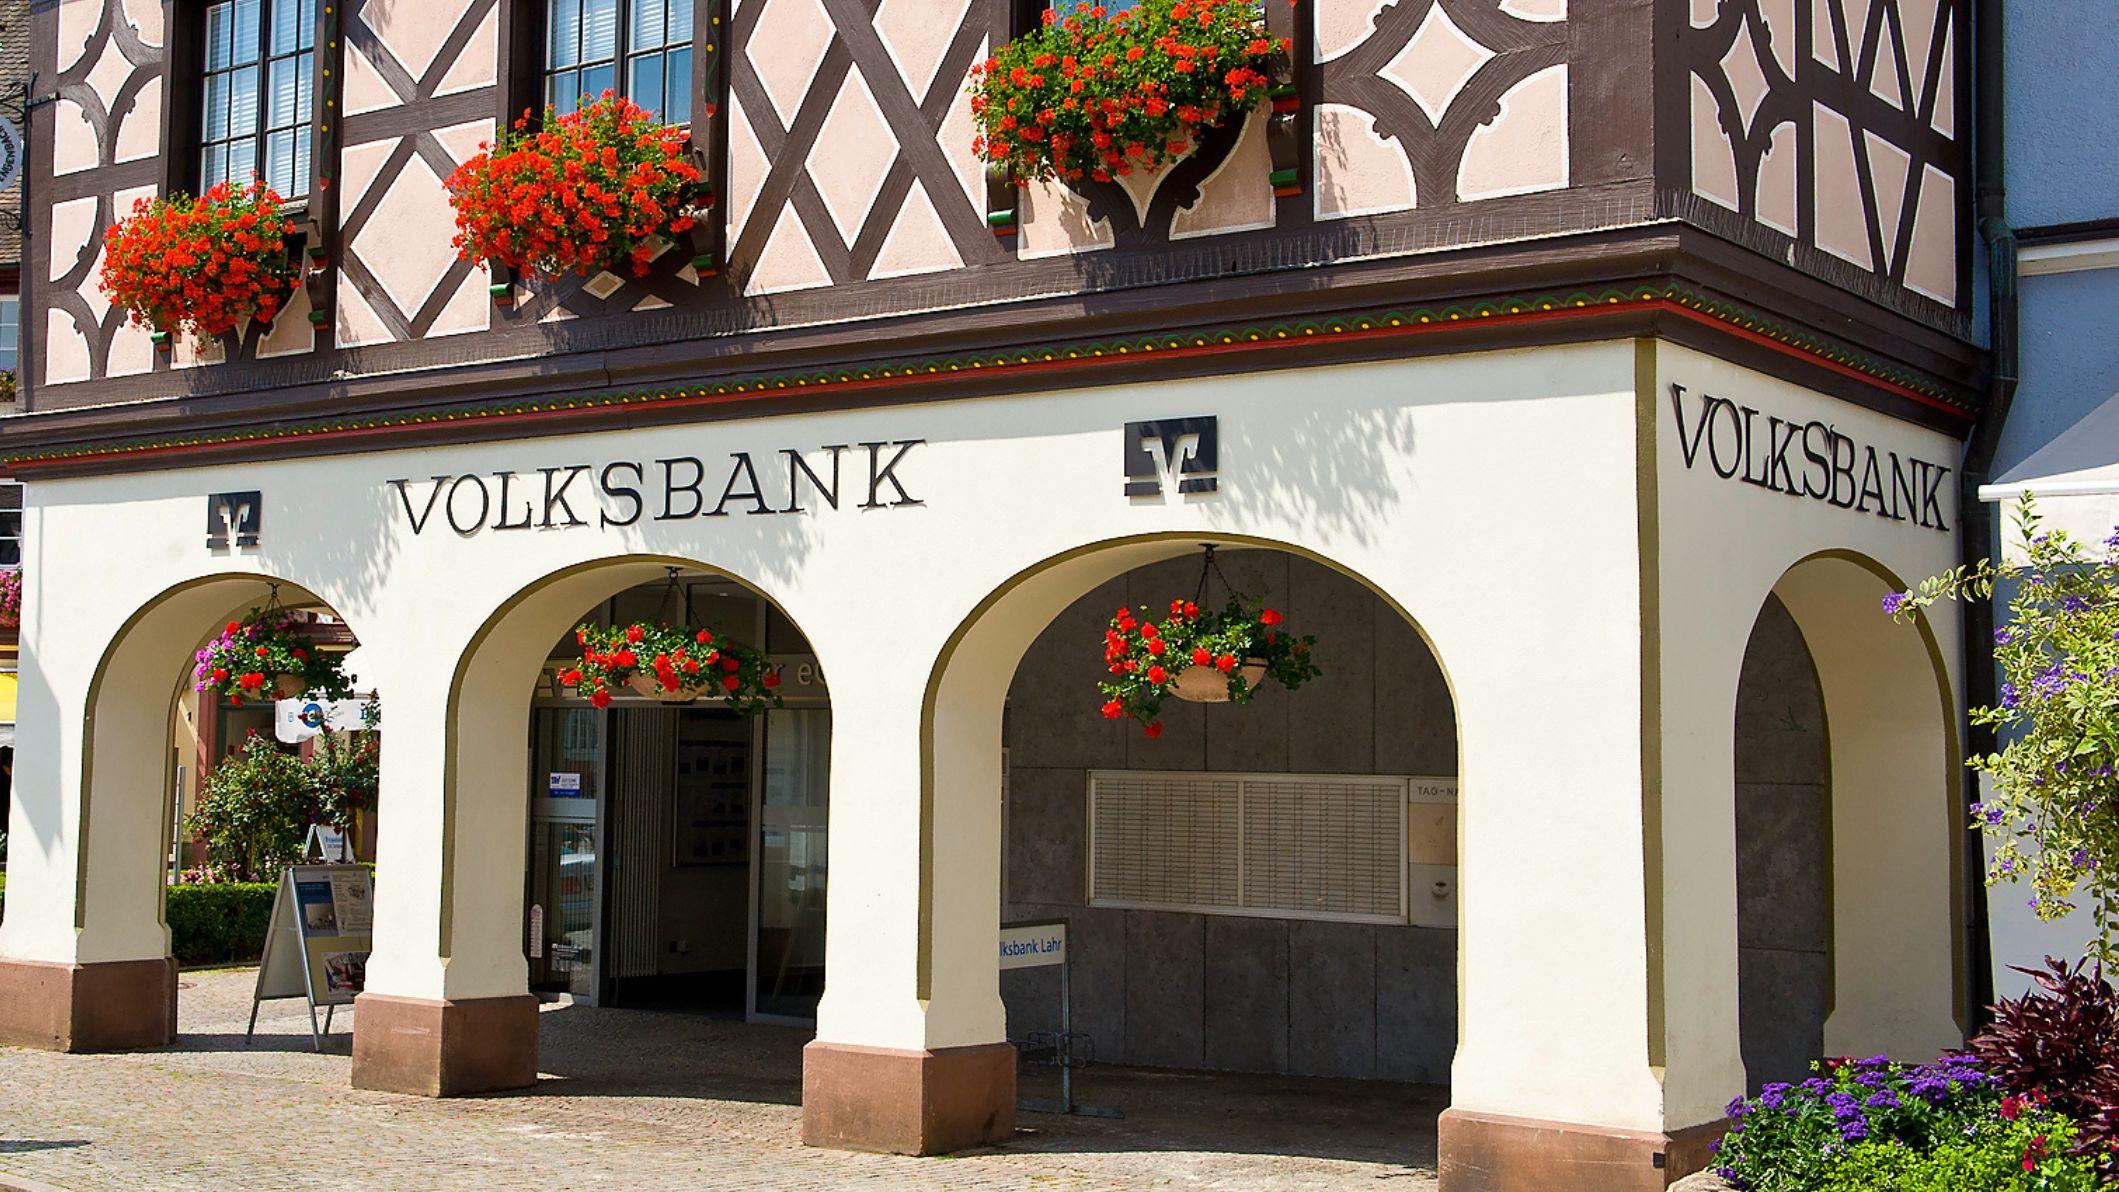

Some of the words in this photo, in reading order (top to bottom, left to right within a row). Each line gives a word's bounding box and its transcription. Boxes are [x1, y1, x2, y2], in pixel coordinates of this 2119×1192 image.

[1671, 382, 1951, 531] VOLKSBANK
[386, 439, 926, 534] VOLKSBANK
[1417, 786, 1457, 796] TAG-N
[1041, 937, 1062, 953] Lahr
